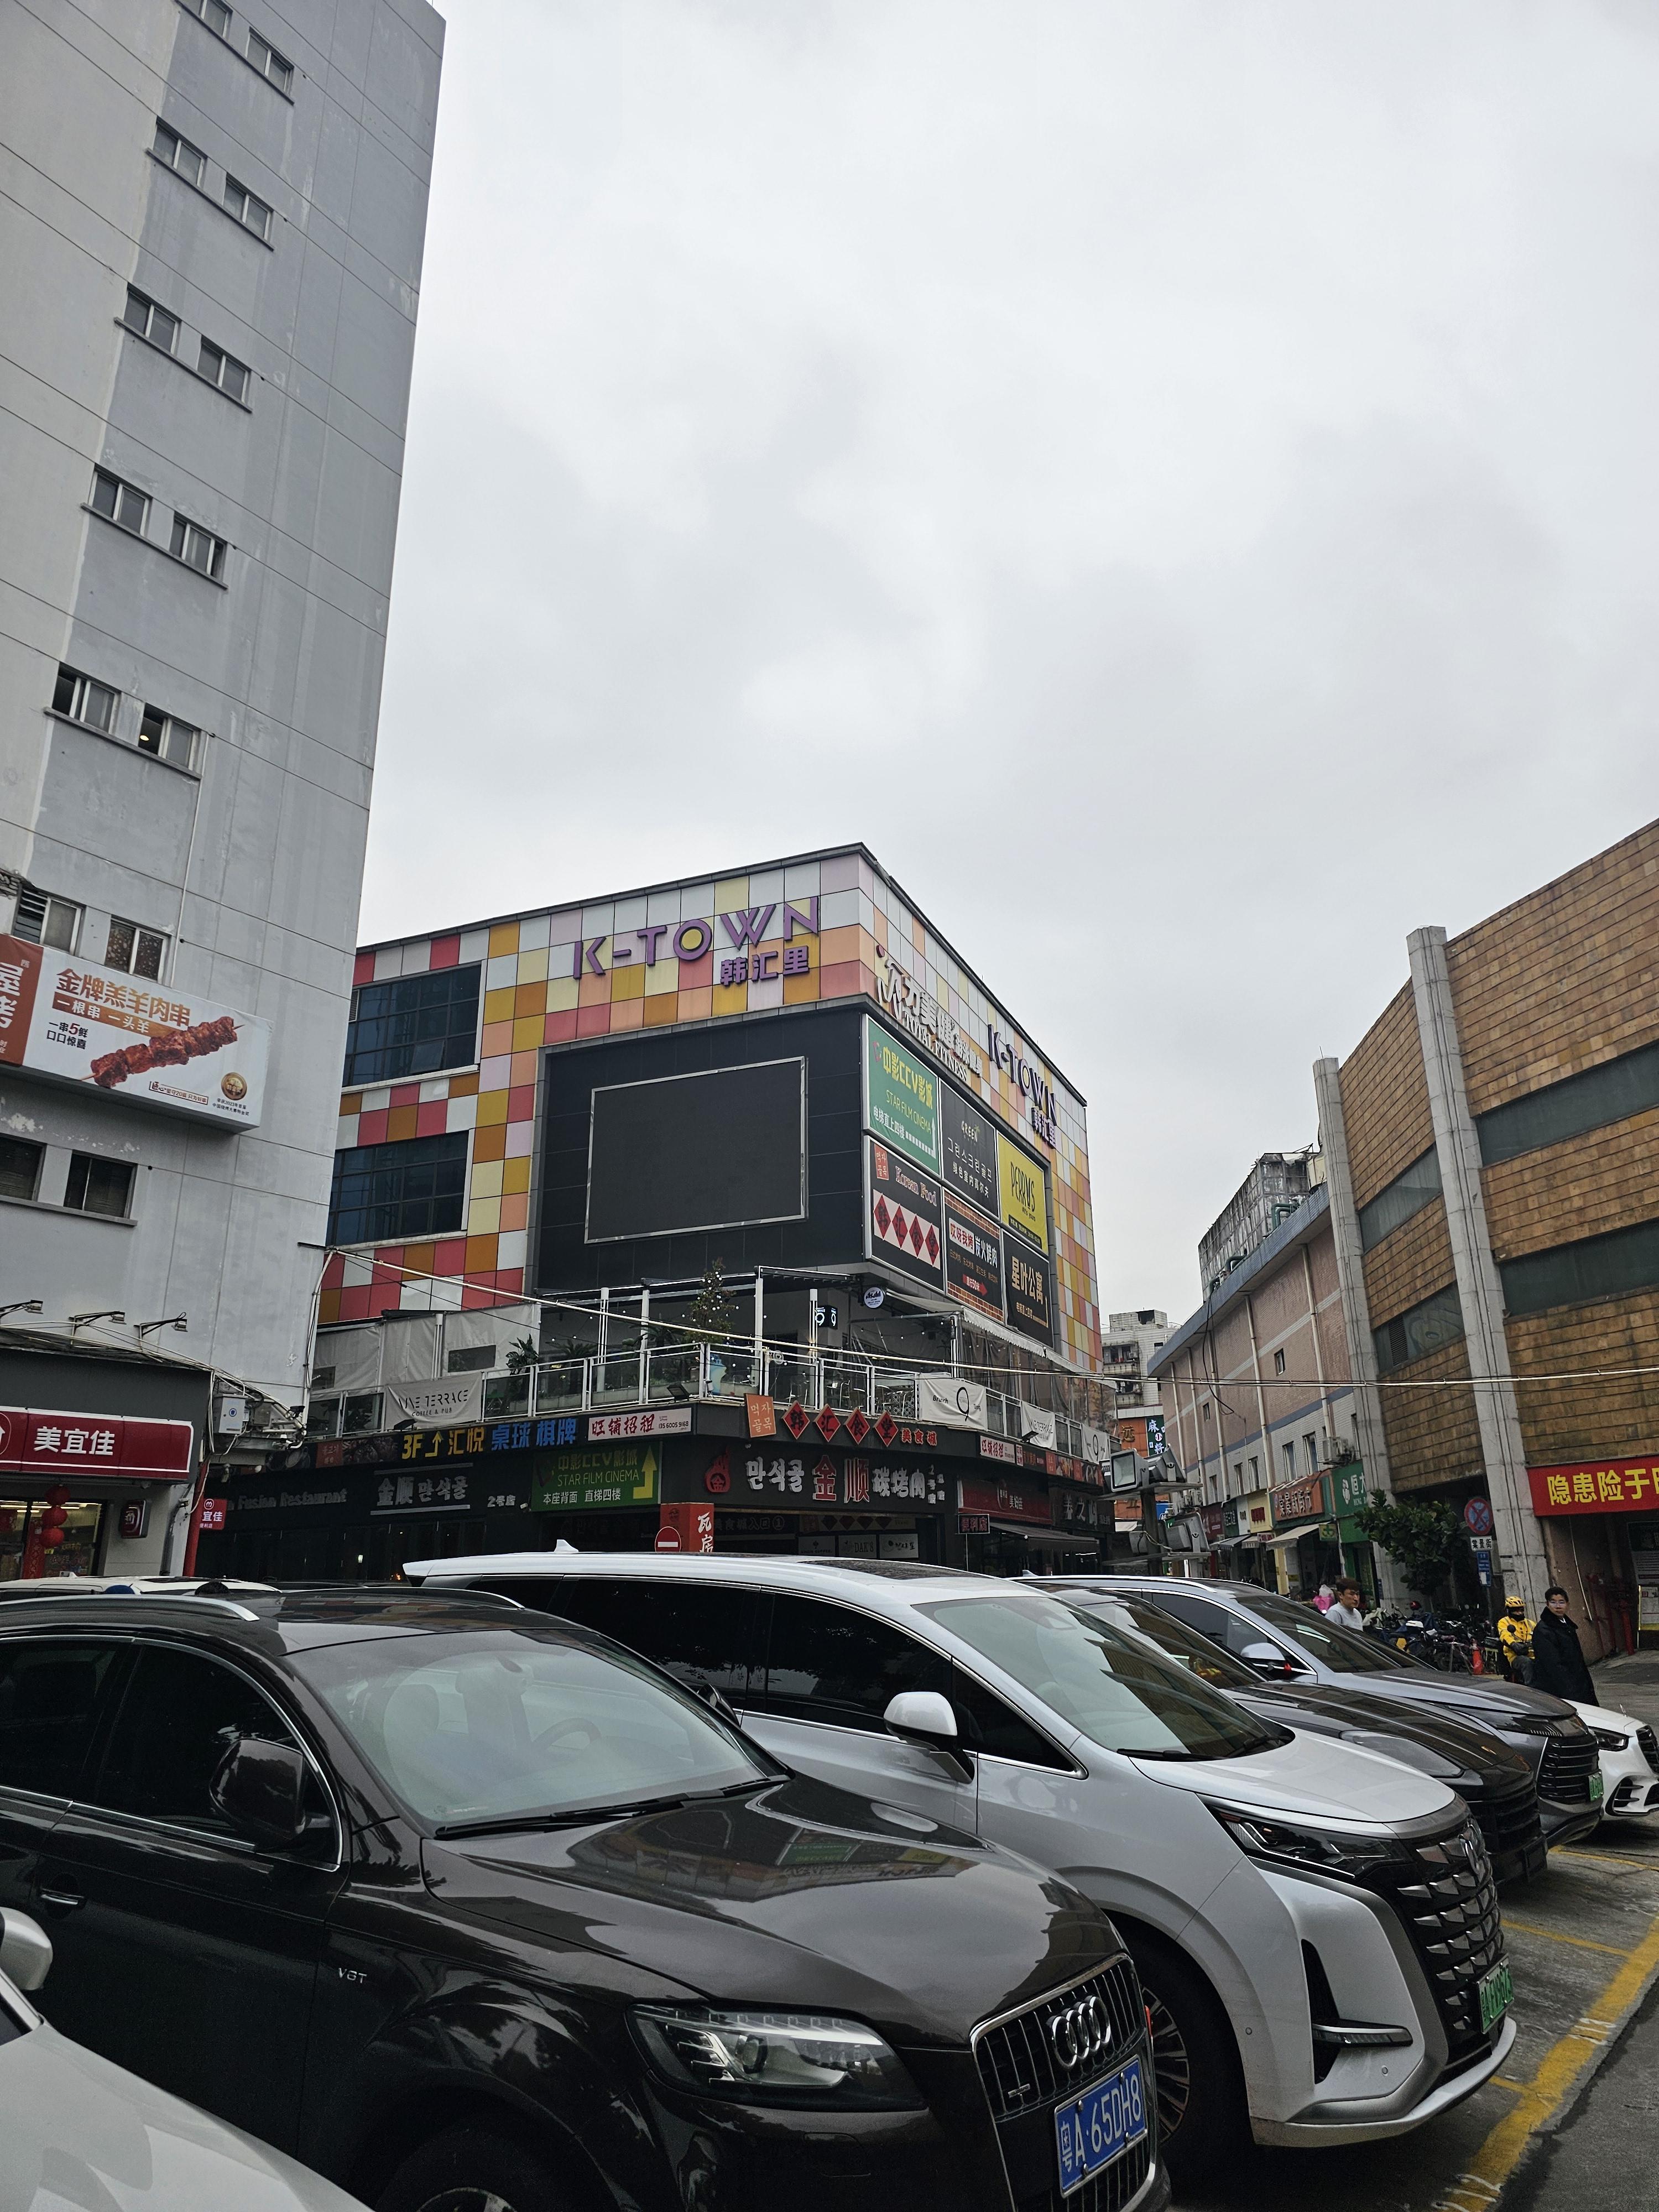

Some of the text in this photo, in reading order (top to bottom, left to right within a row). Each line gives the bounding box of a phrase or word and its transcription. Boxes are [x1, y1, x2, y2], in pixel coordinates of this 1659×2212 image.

[573, 896, 819, 980] K-TOWN
[720, 946, 809, 986] 韩汇里
[56, 968, 191, 1026] 金牌羔羊肉串
[49, 1022, 88, 1038] 一串5鲜
[57, 999, 150, 1033] 一根串 一头羊
[46, 1030, 87, 1050] 口口惊喜
[903, 1011, 968, 1082] TOTAL FITNESS
[988, 1024, 1057, 1126] K-TOWN
[873, 1105, 905, 1140] 电梯直上四楼
[886, 1089, 931, 1135] STAR FILM CINEMA
[961, 1120, 978, 1143] GREEN
[1031, 1107, 1057, 1149] 韩汇里
[947, 1137, 993, 1183] 그린스크린골프
[895, 1165, 938, 1207] Korean Food
[865, 1290, 881, 1300] Asahi
[1011, 1256, 1044, 1305] 星叶公寓
[425, 1389, 469, 1407] TERRACE
[750, 1401, 771, 1416] 먹자
[448, 1417, 576, 1455] 汇悦 桌球 棋牌
[592, 1413, 655, 1436] 旺铺招租
[752, 1417, 773, 1433] 골목
[901, 1427, 938, 1447] 美食城
[34, 1426, 115, 1455] 美宜佳
[401, 1433, 424, 1459] 3F
[558, 1449, 638, 1471] 中影CCV影城
[557, 1469, 639, 1487] STAR FILM CINEMA
[871, 1464, 926, 1500] 碳烤肉
[1547, 1468, 1659, 1506] 隐患险于
[487, 1494, 515, 1507] 2号店
[544, 1488, 621, 1505] 本座背面 直梯四楼
[201, 1511, 222, 1522] 宜佳
